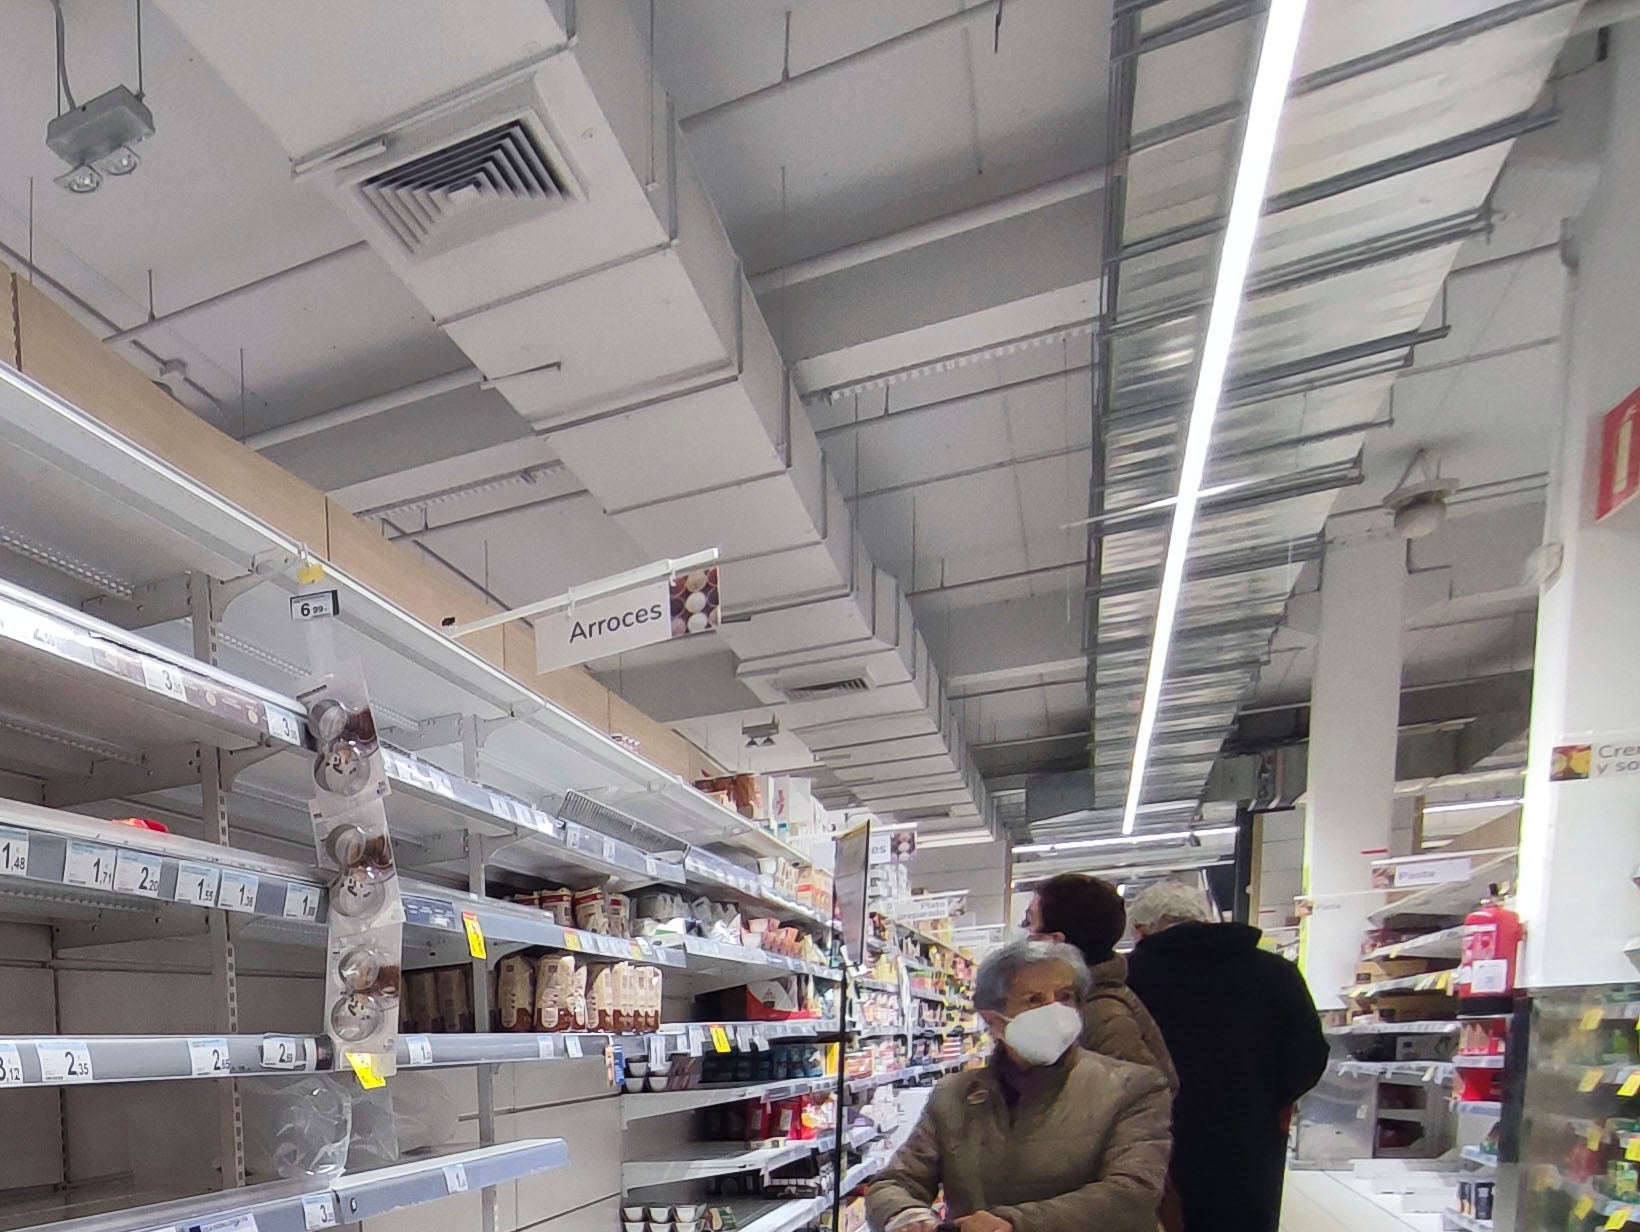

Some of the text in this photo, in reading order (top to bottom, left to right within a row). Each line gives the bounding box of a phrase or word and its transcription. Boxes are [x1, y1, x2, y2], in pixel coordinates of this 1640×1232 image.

[568, 602, 663, 645] Arroces
[1596, 764, 1609, 777] y
[2, 842, 26, 872] 1,48
[93, 857, 112, 885] 1,71
[138, 866, 159, 892] 2,20
[1398, 870, 1436, 881] Pasta
[64, 1051, 89, 1077] 2,35
